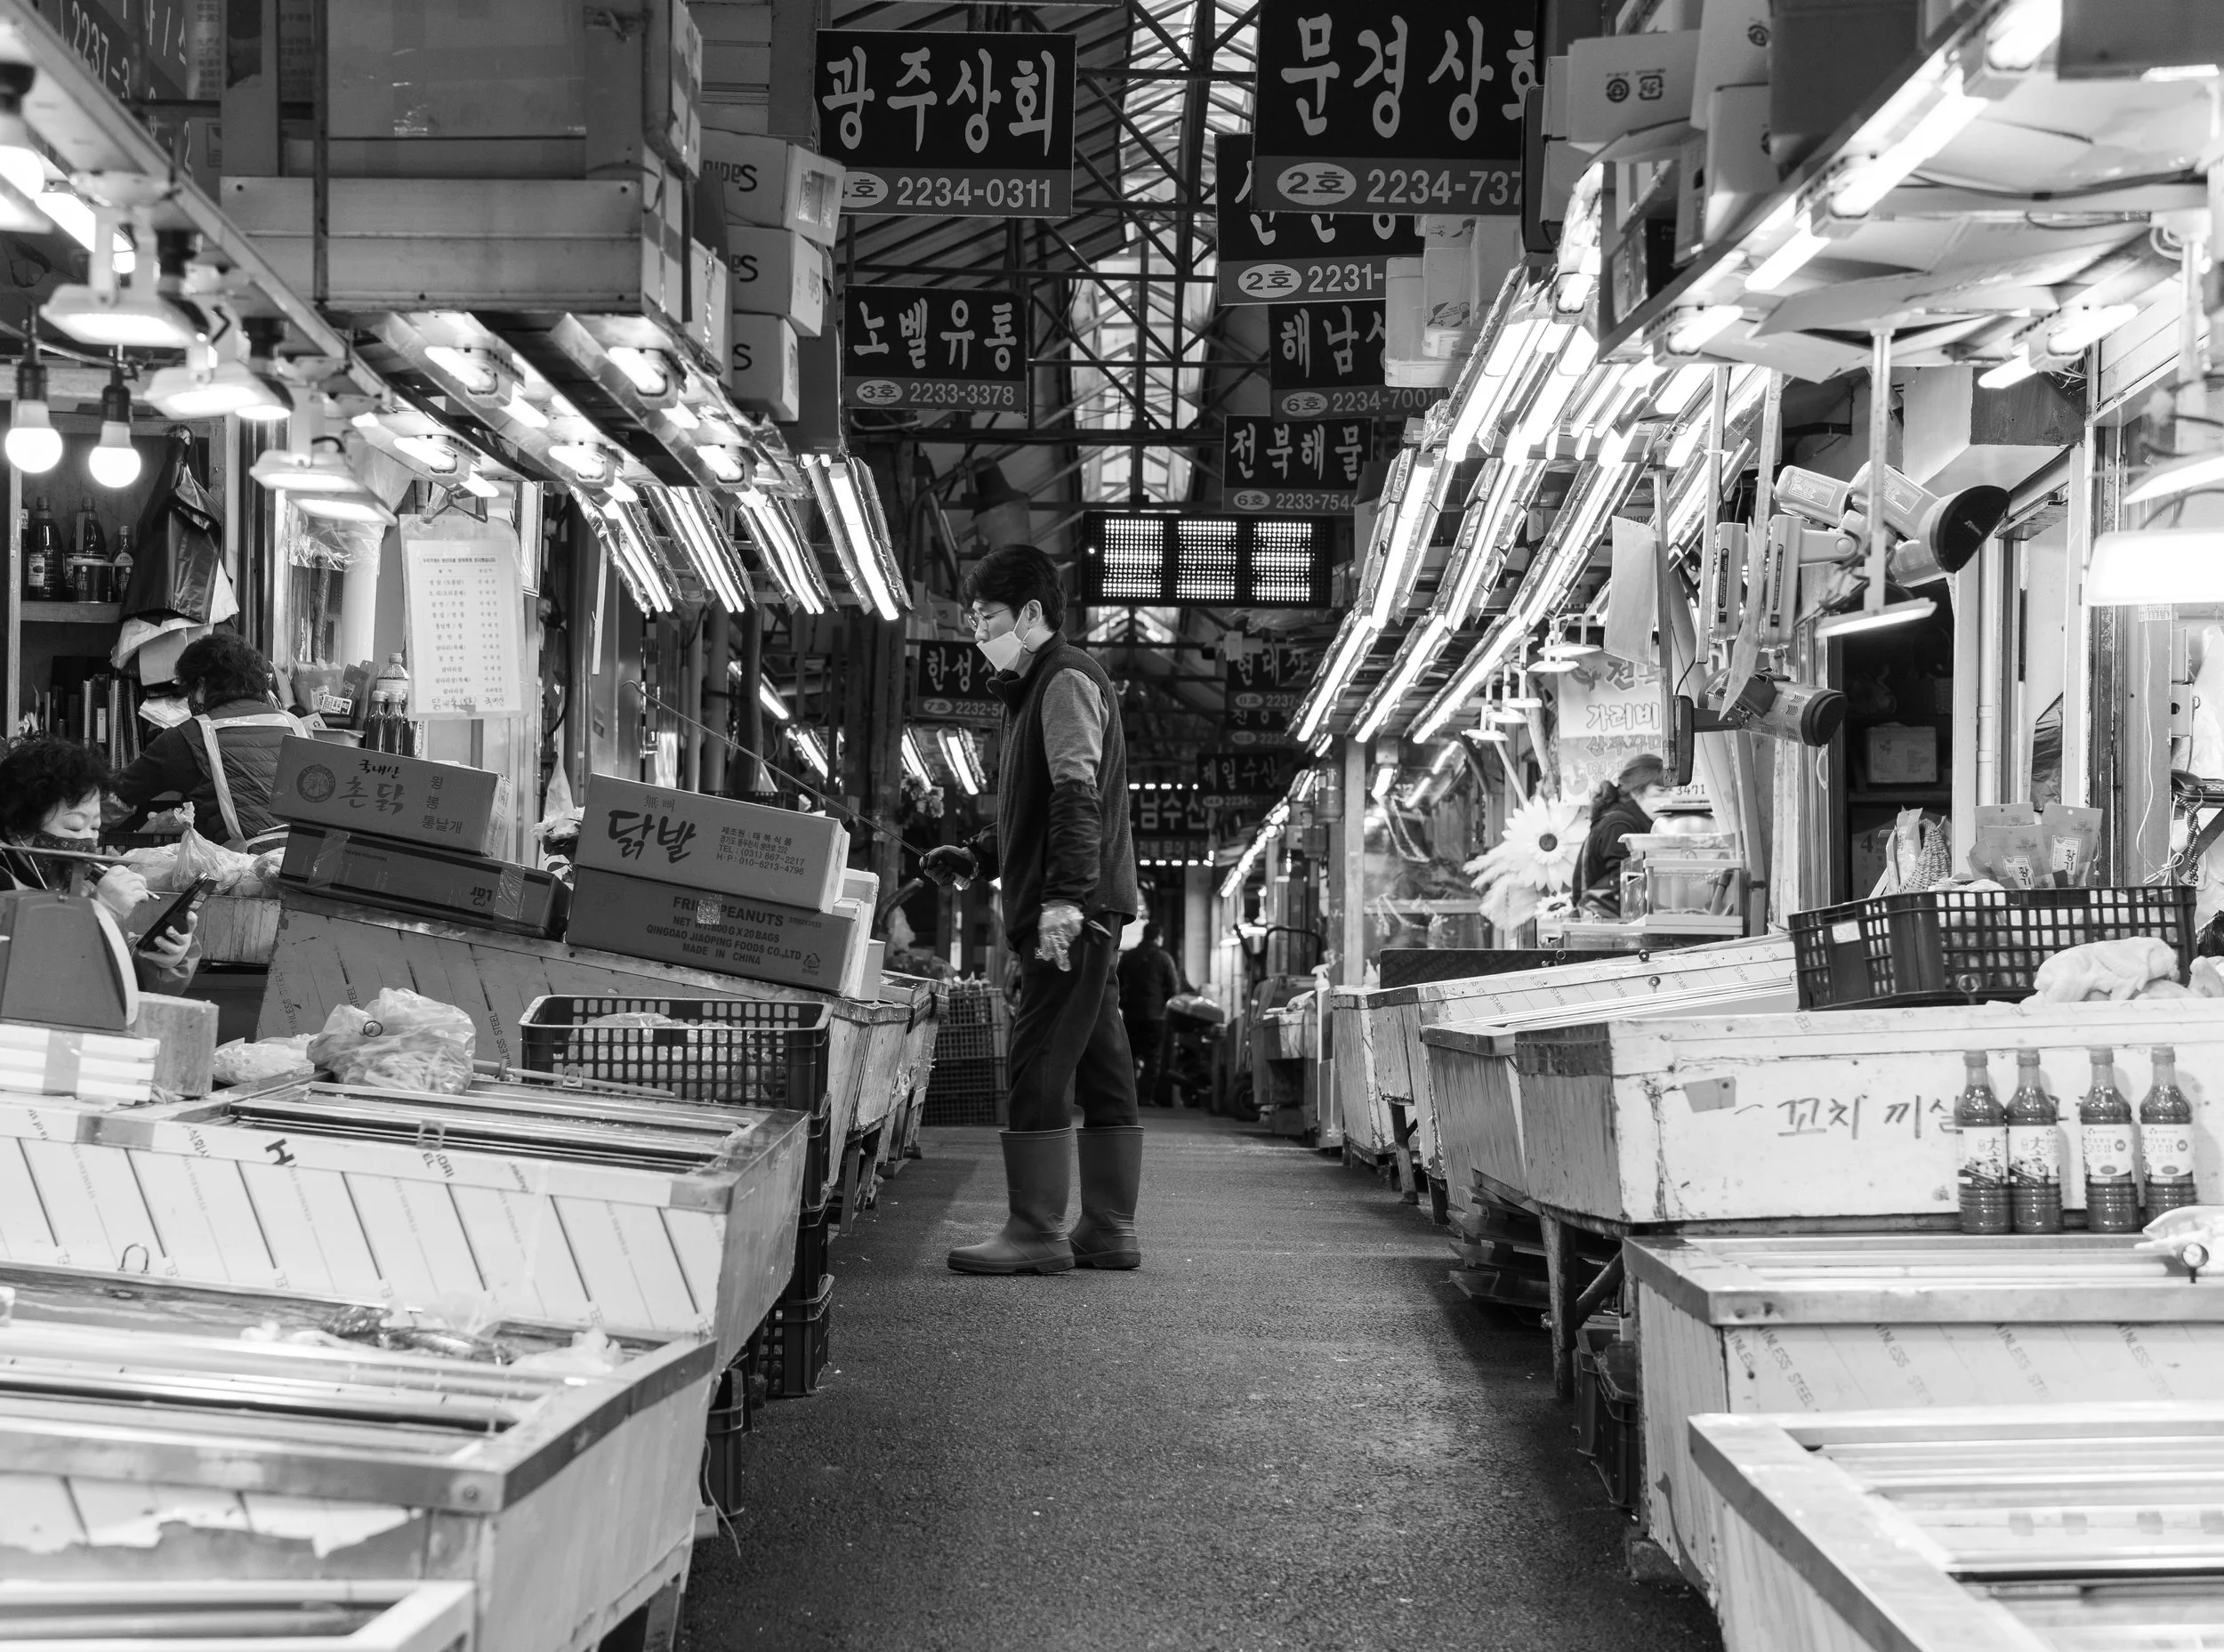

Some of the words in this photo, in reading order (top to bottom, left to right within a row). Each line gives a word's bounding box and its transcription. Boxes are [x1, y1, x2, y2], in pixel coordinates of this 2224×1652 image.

[822, 45, 1056, 157] 광주상회
[841, 179, 877, 199] 호
[897, 176, 1051, 209] 2234-0311
[1286, 171, 1345, 195] 2호
[1246, 270, 1293, 290] 2호
[853, 297, 1018, 372] 노벨유통
[909, 383, 1015, 406] 2233-3378
[1230, 423, 1363, 481] 전북해물
[955, 702, 1003, 716] 2232-5
[1586, 703, 1660, 731] 가리비
[359, 759, 399, 778] 국내산
[1130, 792, 1207, 830] 남수산
[423, 816, 463, 834] 통날개
[608, 810, 697, 864] 닭발
[719, 843, 733, 854] TEL
[740, 848, 762, 859] (031)
[764, 852, 805, 867] 867-2217
[673, 915, 691, 928] NET
[721, 904, 784, 927] PEANUTS
[647, 924, 688, 940] QINGDAO
[689, 931, 732, 948] JIAOPING
[735, 939, 765, 954] FOODS
[682, 943, 708, 956] MADE
[715, 948, 725, 959] IN
[732, 951, 761, 965] CHINA
[488, 1012, 504, 1036] STEEL
[1787, 1373, 1816, 1409] STEEL
